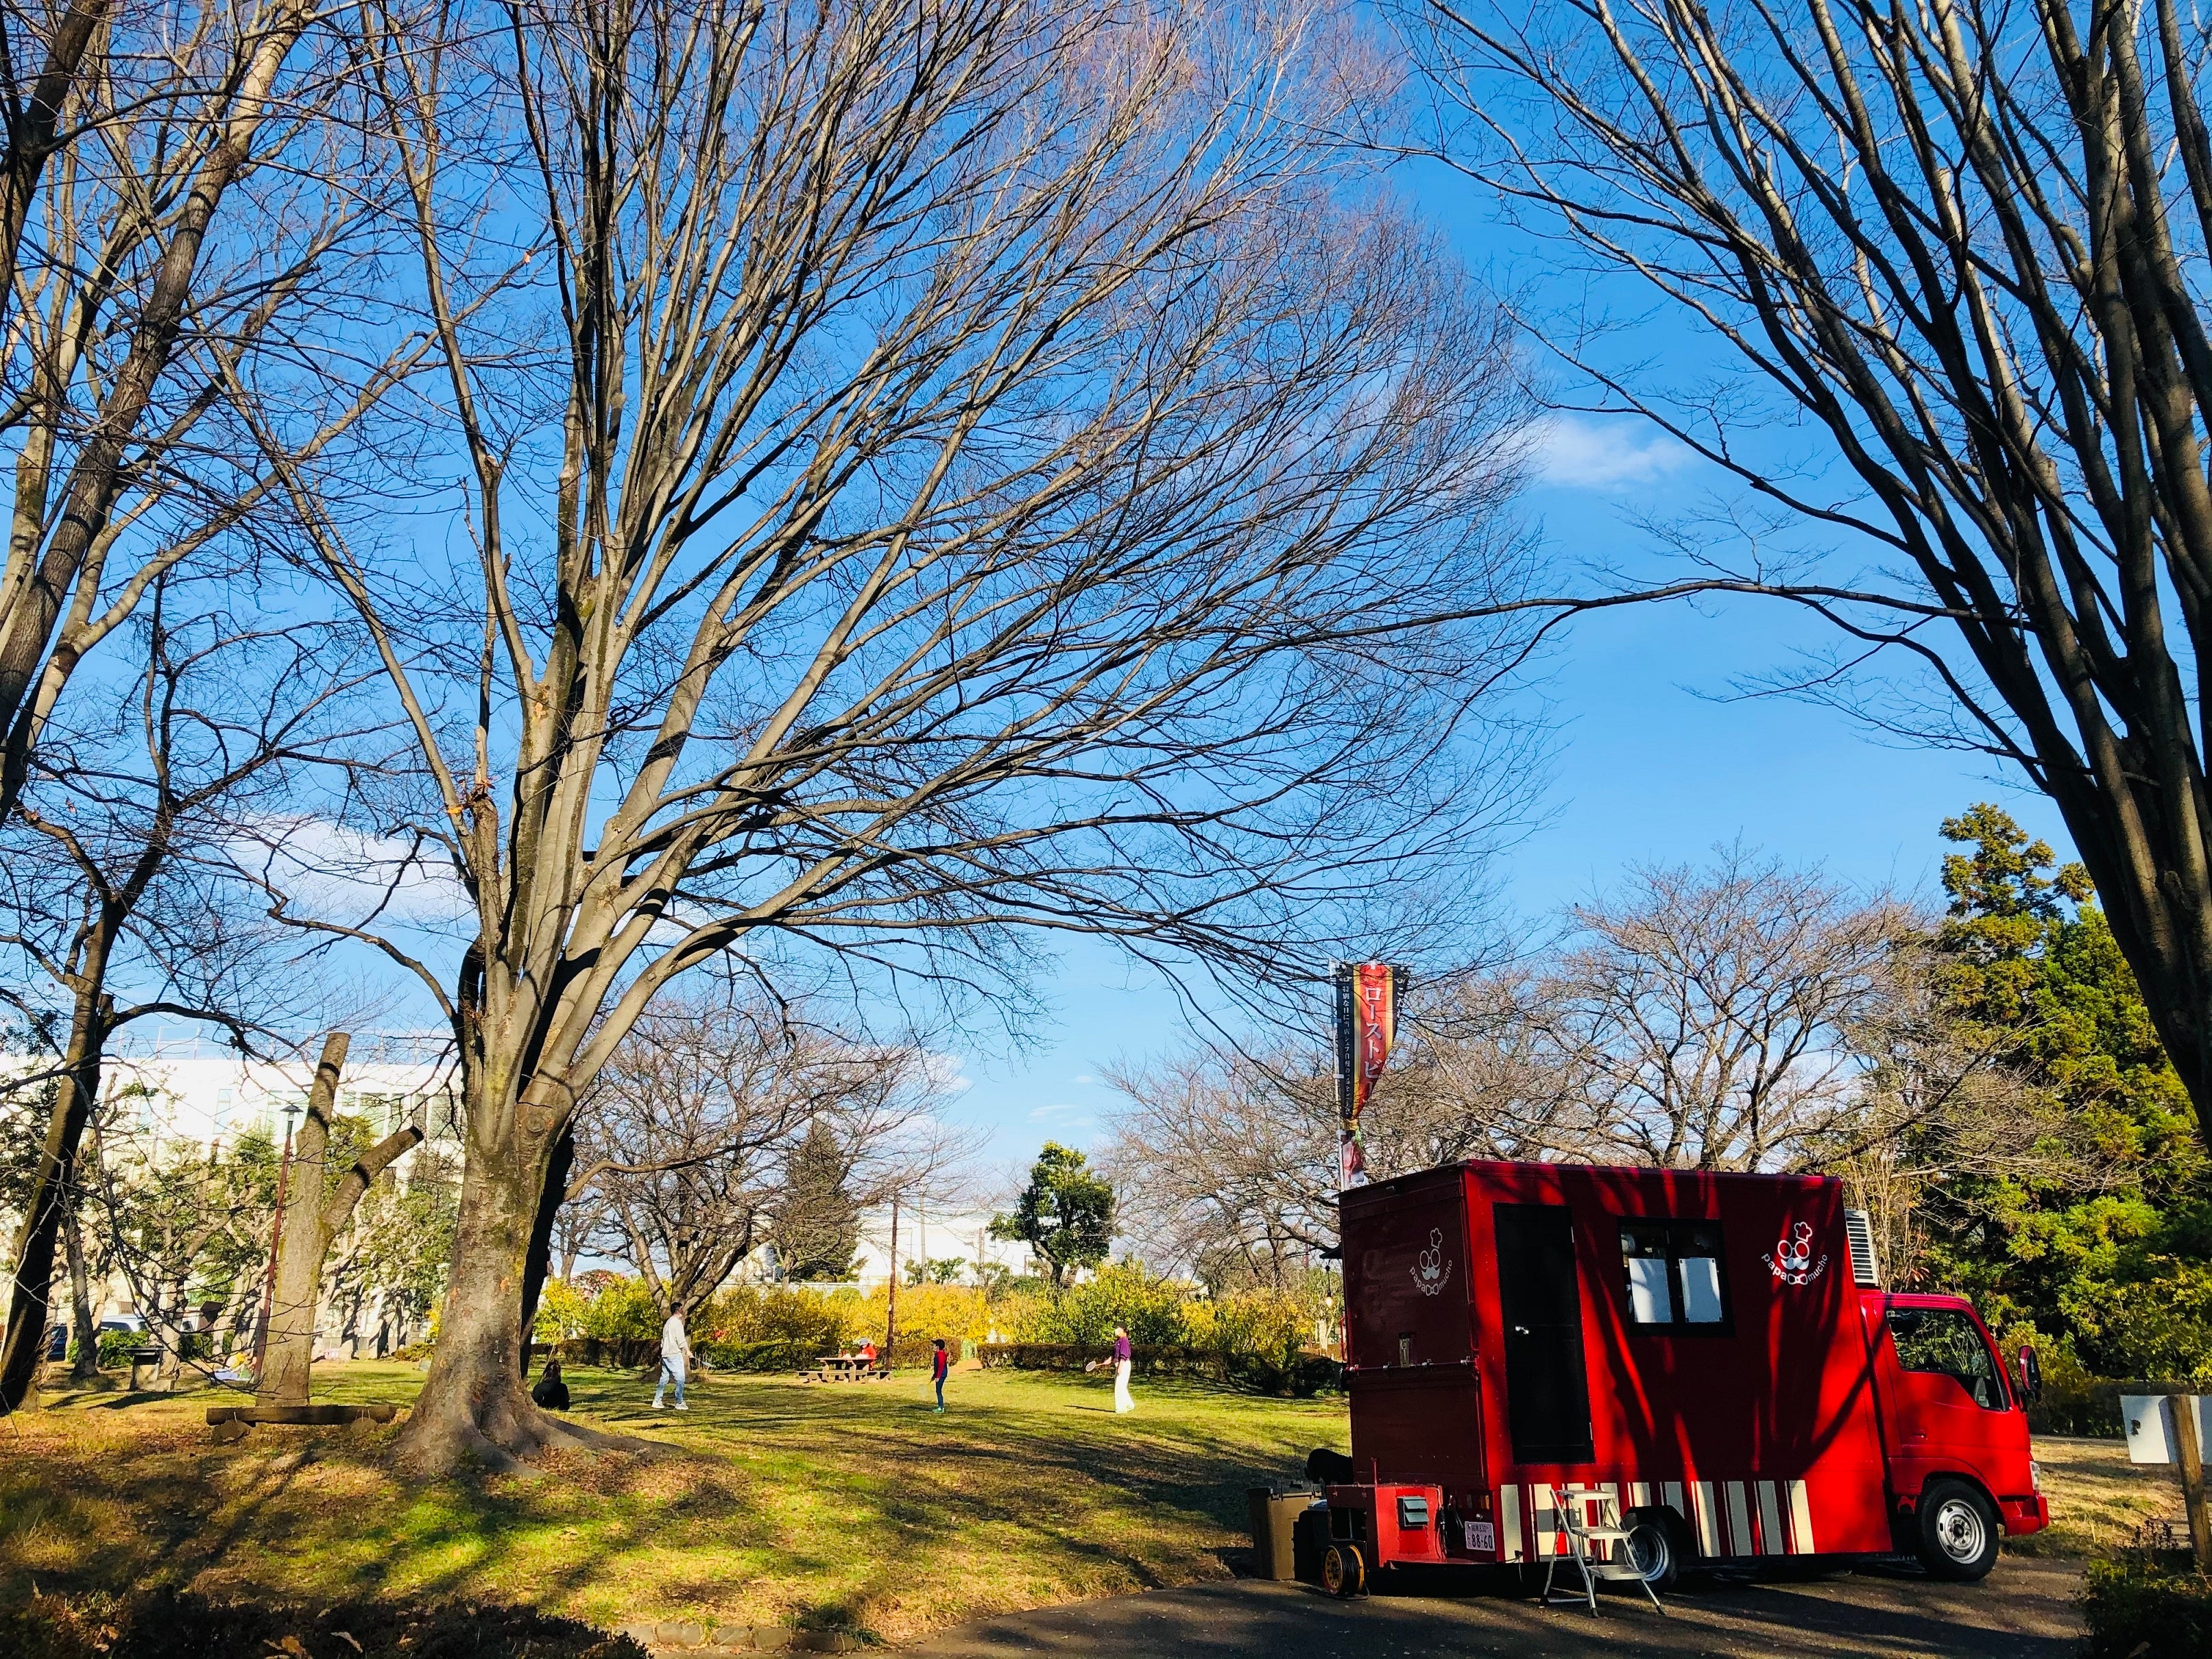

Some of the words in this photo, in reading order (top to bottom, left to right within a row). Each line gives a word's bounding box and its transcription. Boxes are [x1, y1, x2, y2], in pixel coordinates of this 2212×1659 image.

[1409, 1266, 1426, 1292] papa
[1439, 1259, 1453, 1290] mucho
[1761, 1253, 1787, 1281] papa
[1807, 1254, 1828, 1281] mucho
[1471, 1534, 1493, 1549] 88-60
